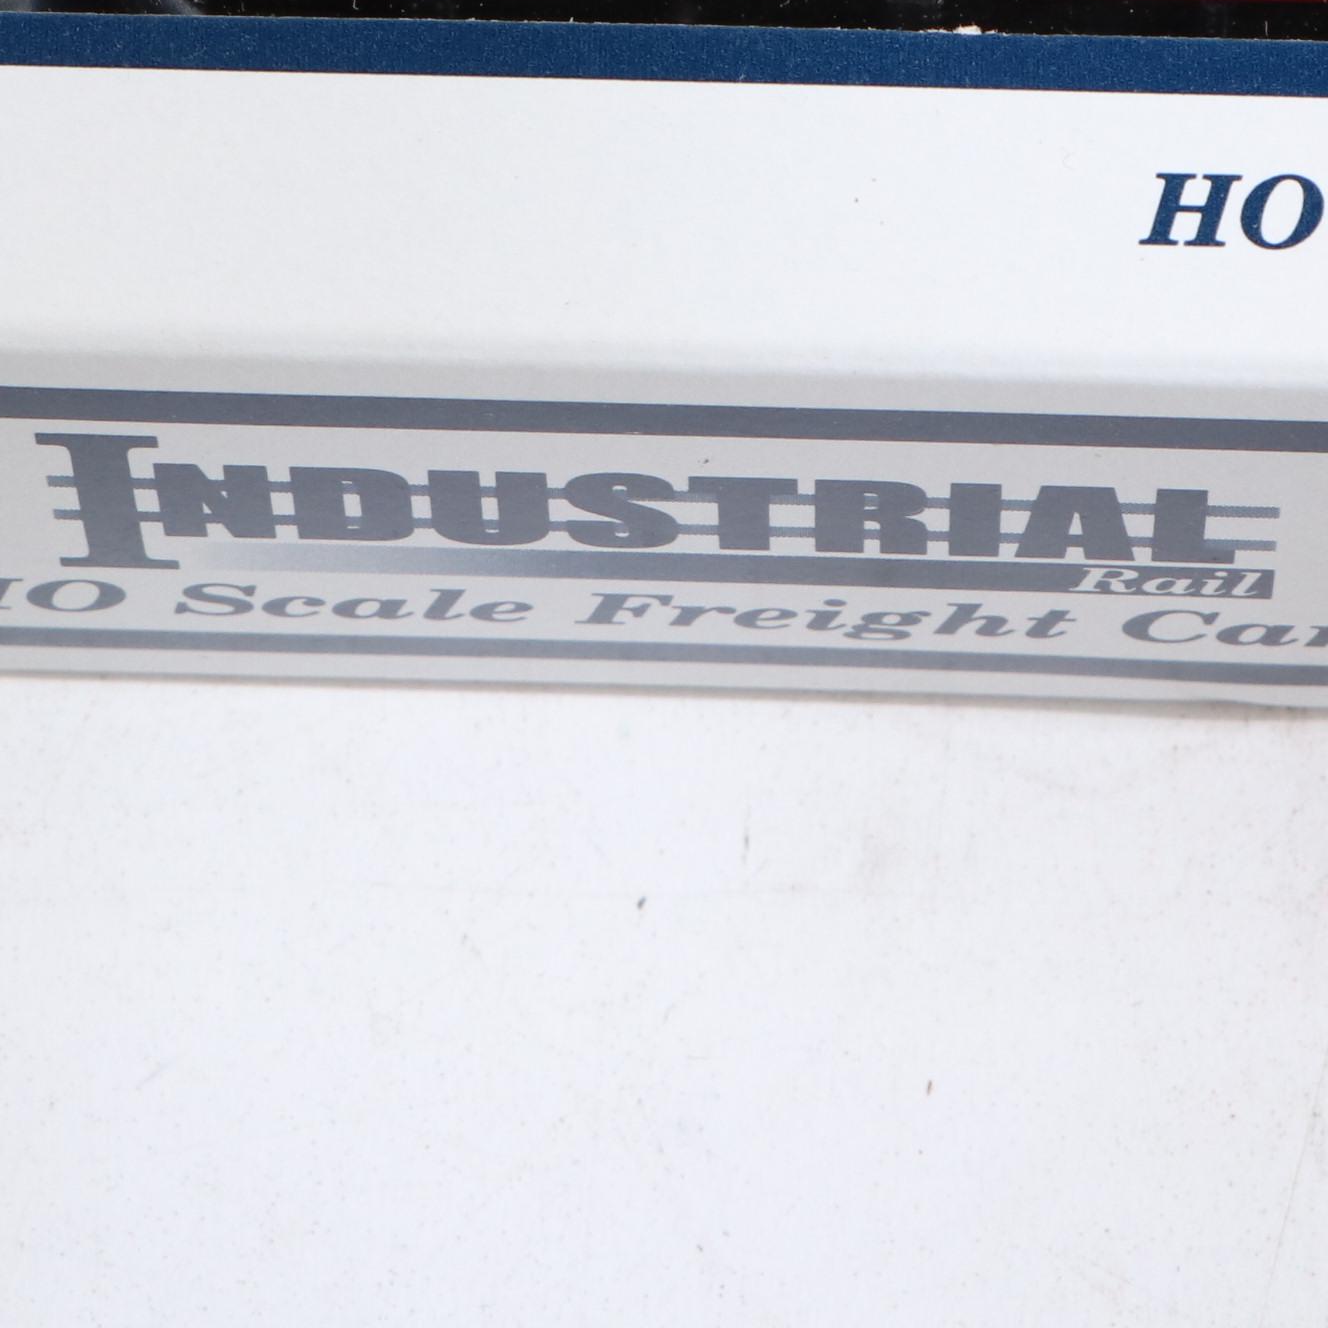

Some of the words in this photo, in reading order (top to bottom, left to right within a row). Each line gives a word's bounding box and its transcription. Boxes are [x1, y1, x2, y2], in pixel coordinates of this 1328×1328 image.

[1137, 172, 1325, 250] HO
[34, 432, 1235, 570] INDUSTRIAL
[173, 582, 535, 623] Scale
[573, 591, 1078, 643] Freight
[1069, 566, 1262, 598] Rail
